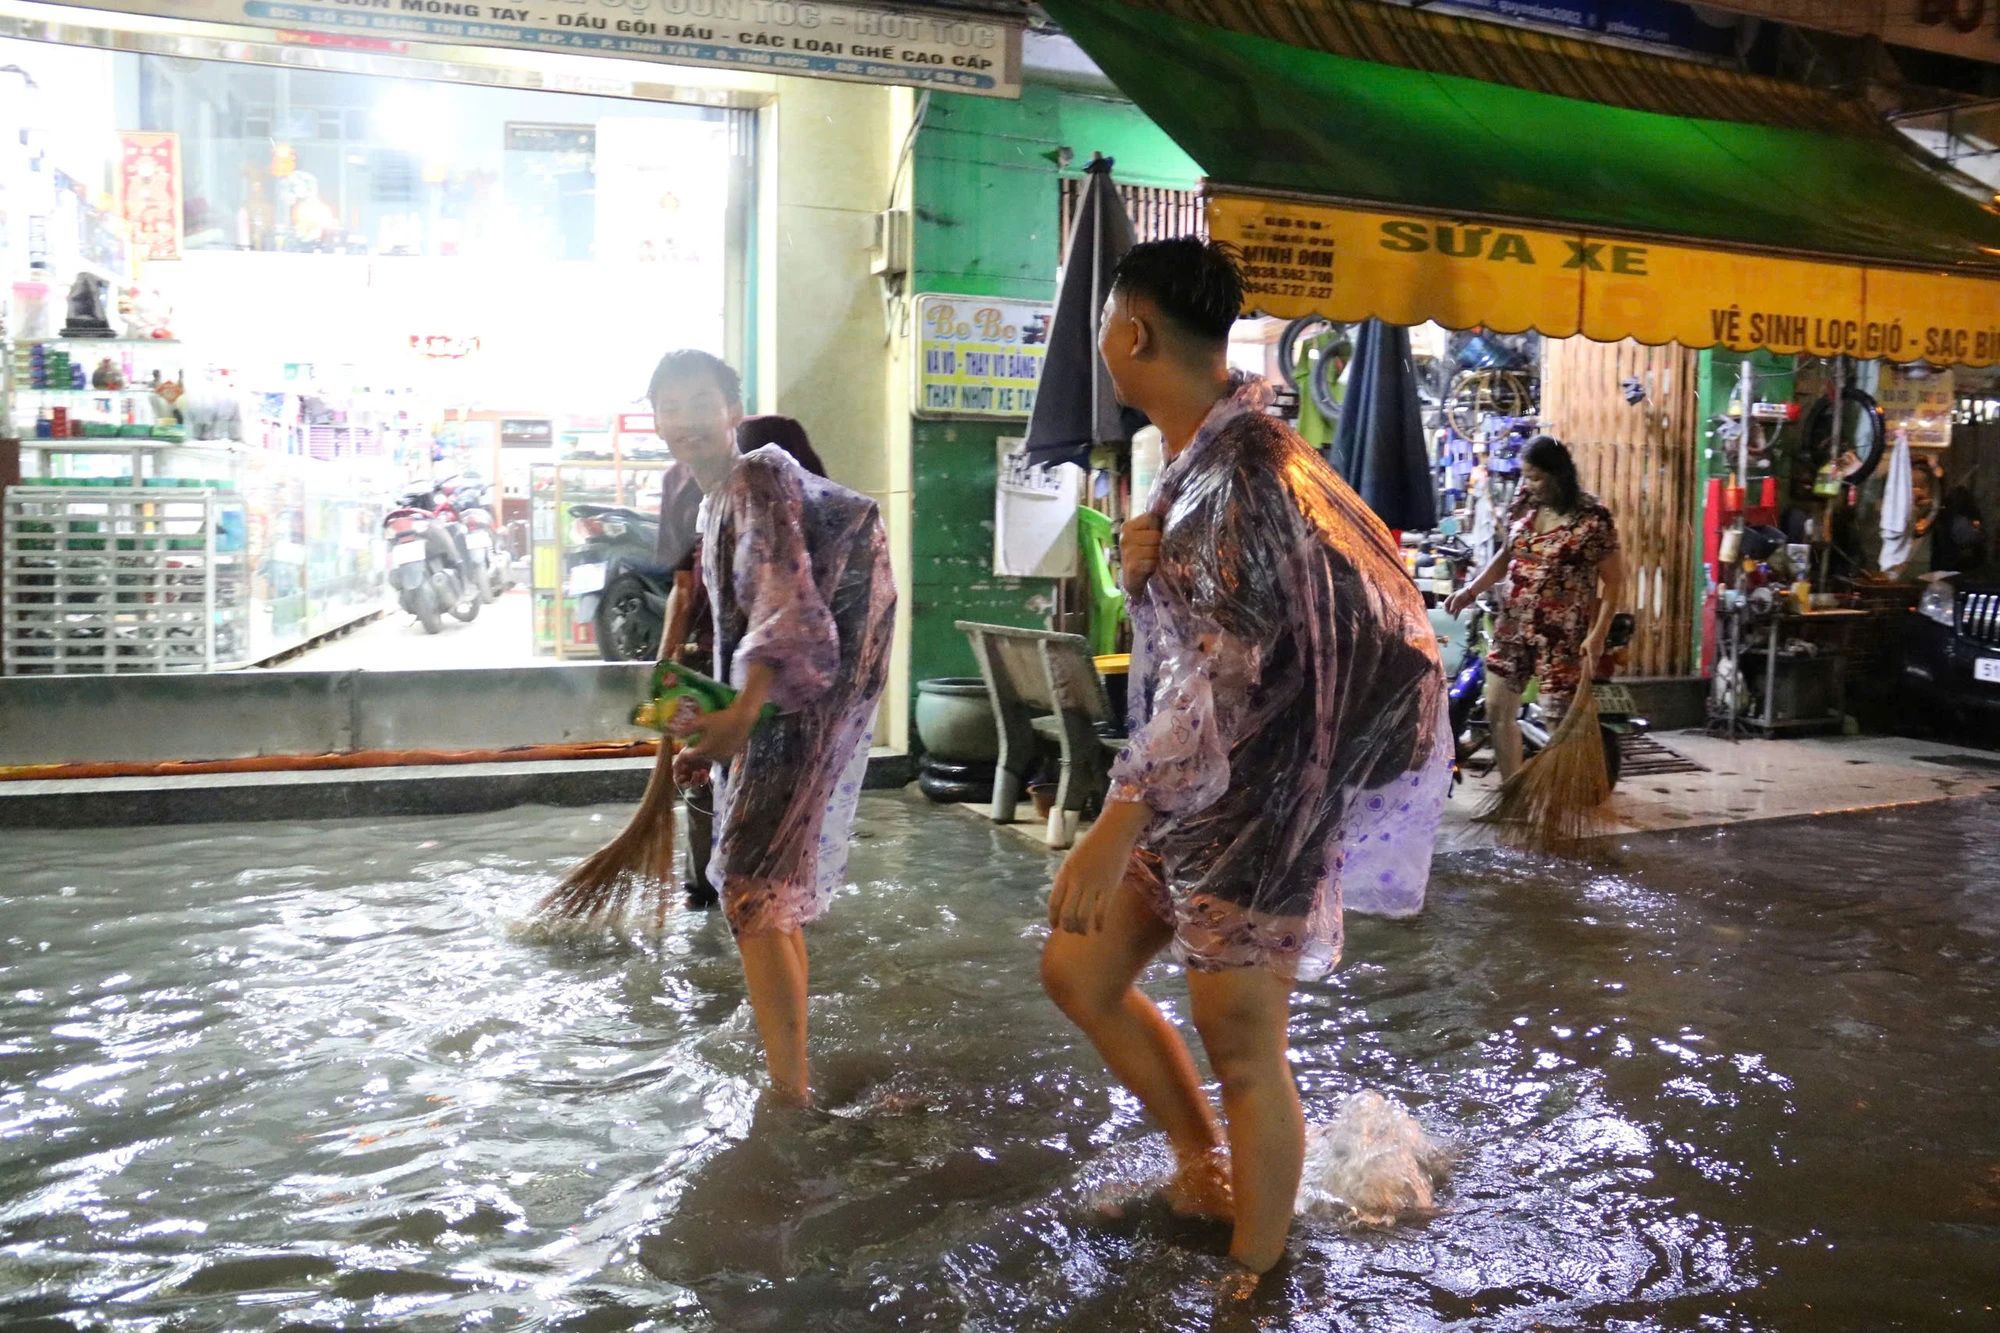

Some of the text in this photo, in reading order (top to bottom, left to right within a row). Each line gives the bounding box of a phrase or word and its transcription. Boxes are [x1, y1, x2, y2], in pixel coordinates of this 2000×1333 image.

[489, 7, 530, 21] TAY
[616, 19, 656, 35] GỘI
[739, 31, 785, 47] CÁC
[793, 38, 843, 55] LOẠI
[851, 45, 896, 60] GHẾ
[902, 50, 945, 65] CAO
[951, 54, 993, 70] CẤP
[1380, 219, 1649, 276] SỬA XE
[1750, 312, 1807, 345] SINH
[1867, 318, 1902, 353] GIÓ
